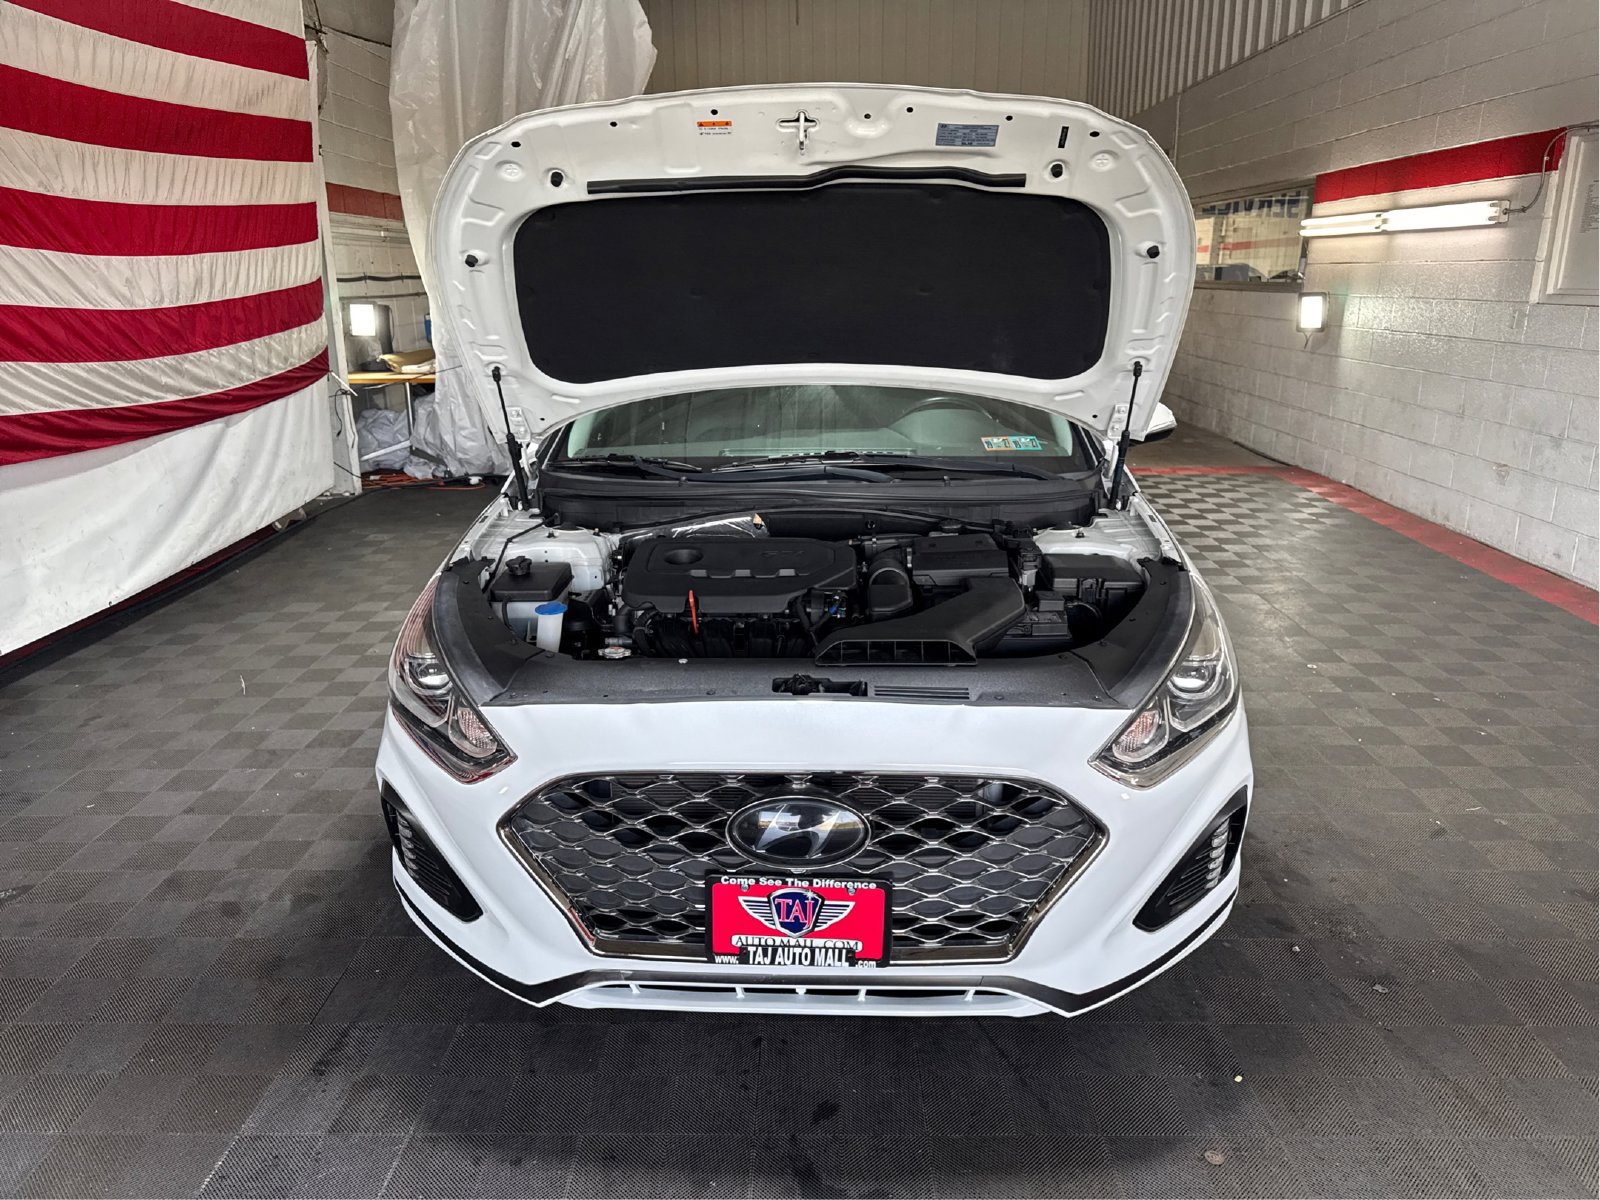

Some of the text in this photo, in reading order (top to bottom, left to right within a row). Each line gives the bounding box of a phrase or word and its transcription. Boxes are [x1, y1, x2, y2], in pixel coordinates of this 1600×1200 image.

[721, 875, 877, 890] Come See The Difference
[775, 898, 814, 930] TAJ
[748, 947, 772, 965] TAJ
[775, 948, 811, 967] AUTO
[814, 949, 849, 968] MALL
[855, 960, 877, 969] .com
